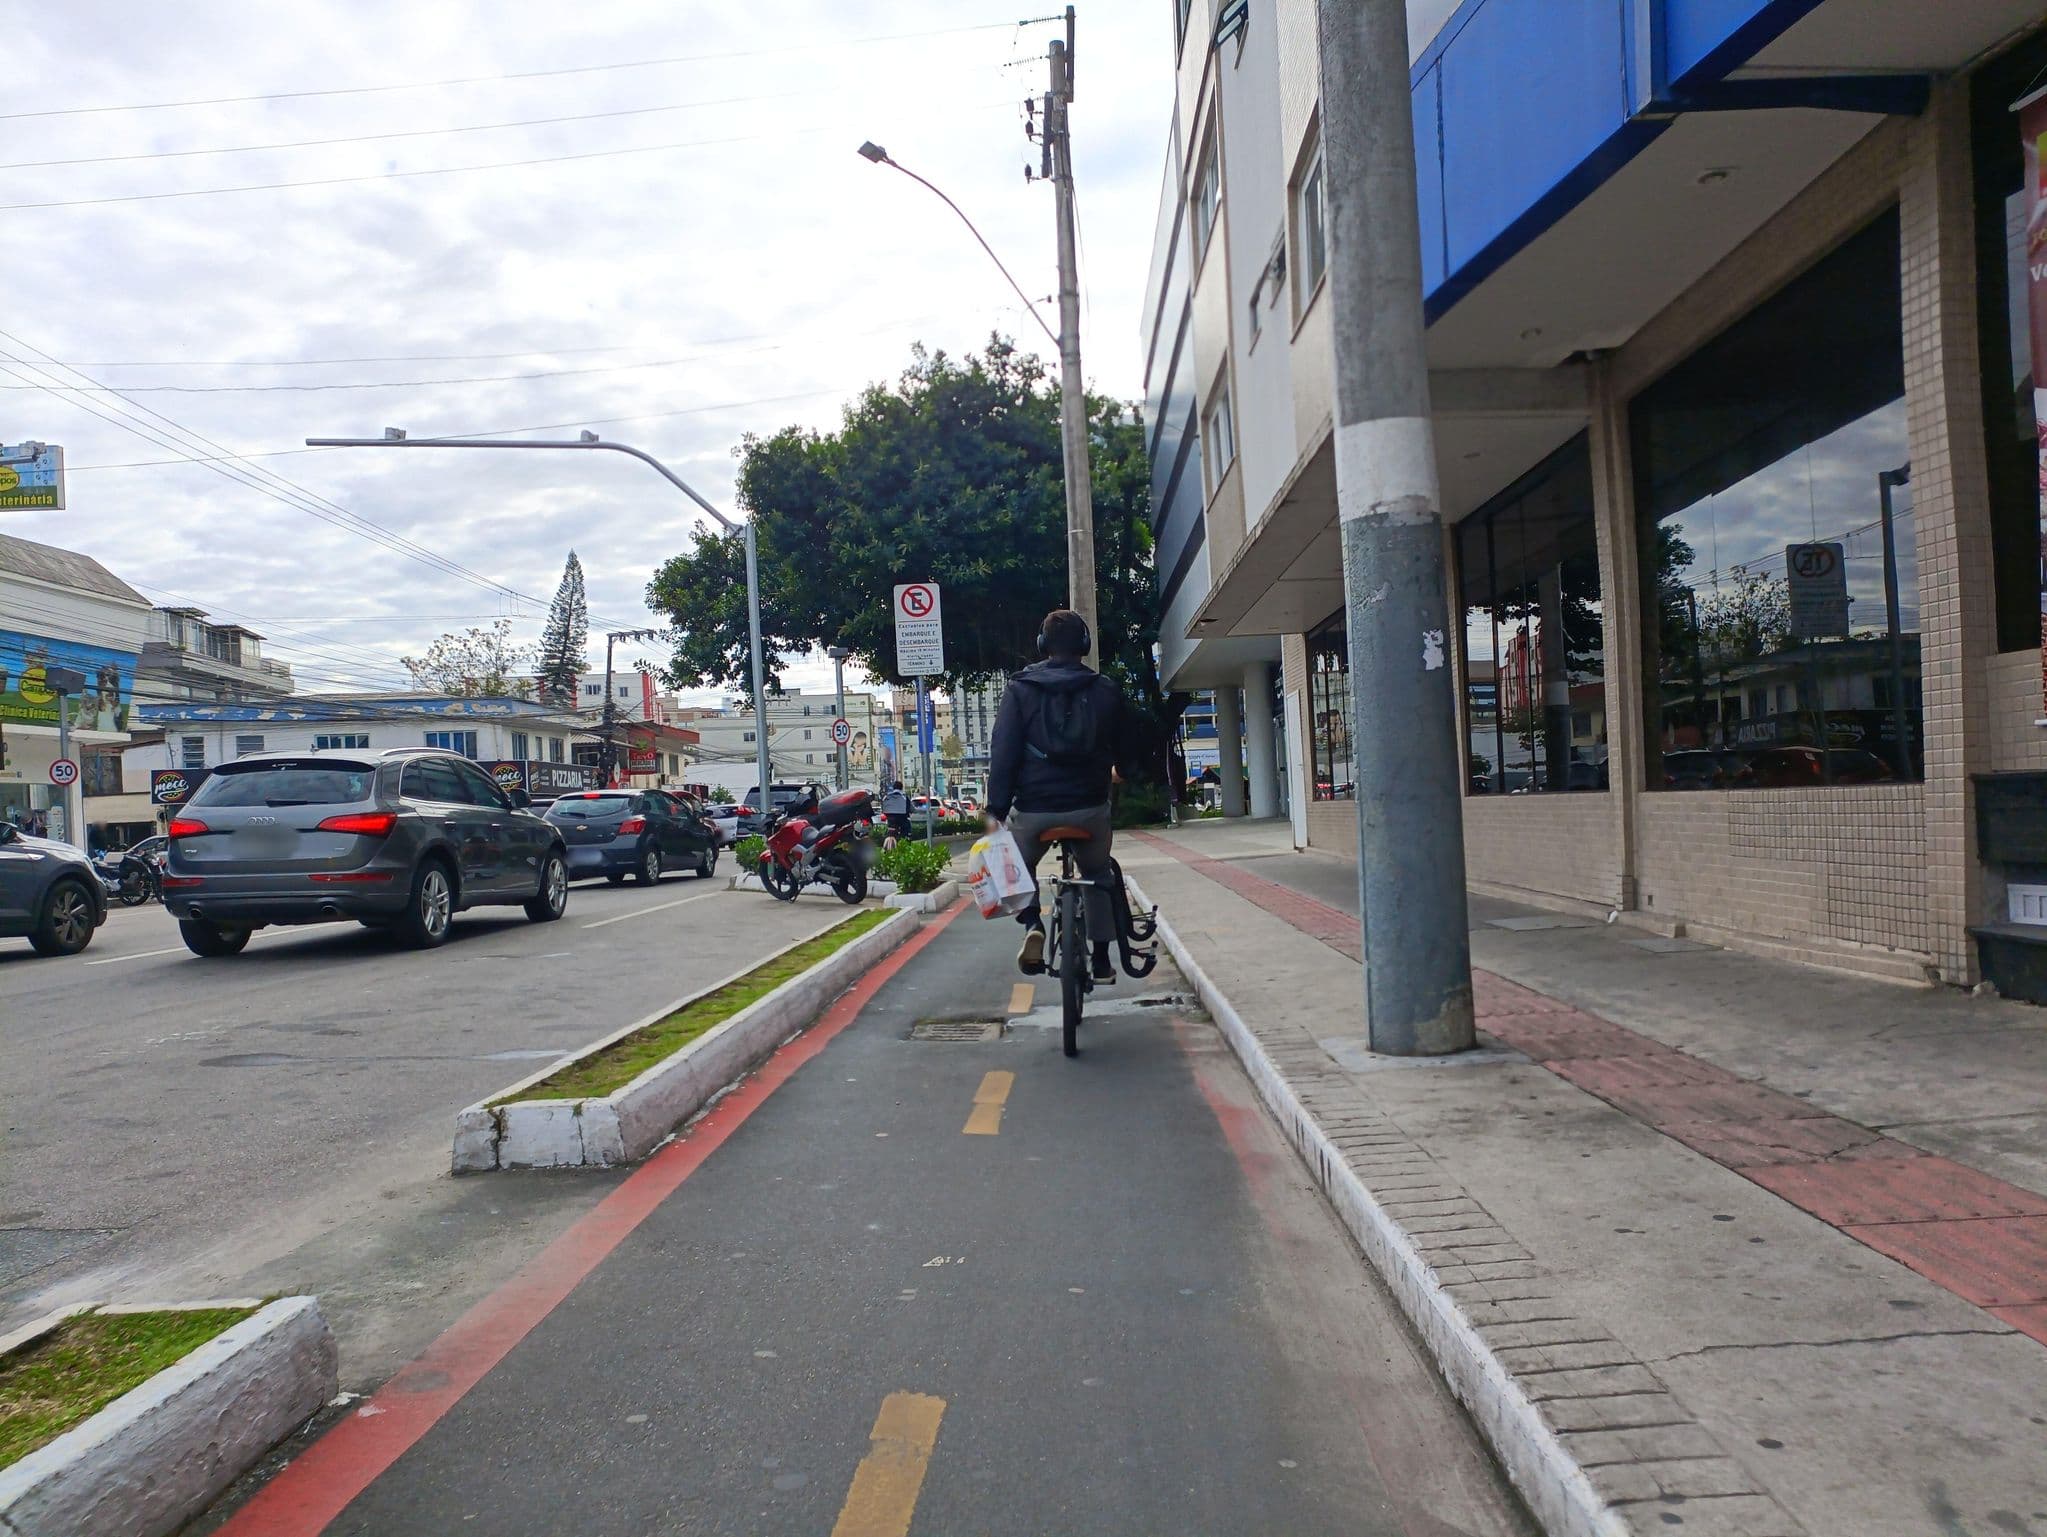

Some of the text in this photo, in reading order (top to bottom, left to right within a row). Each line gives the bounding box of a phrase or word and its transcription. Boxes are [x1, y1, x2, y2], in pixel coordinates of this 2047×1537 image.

[836, 725, 848, 736] 50
[55, 765, 73, 777] 50
[551, 769, 583, 788] PIZZARIA
